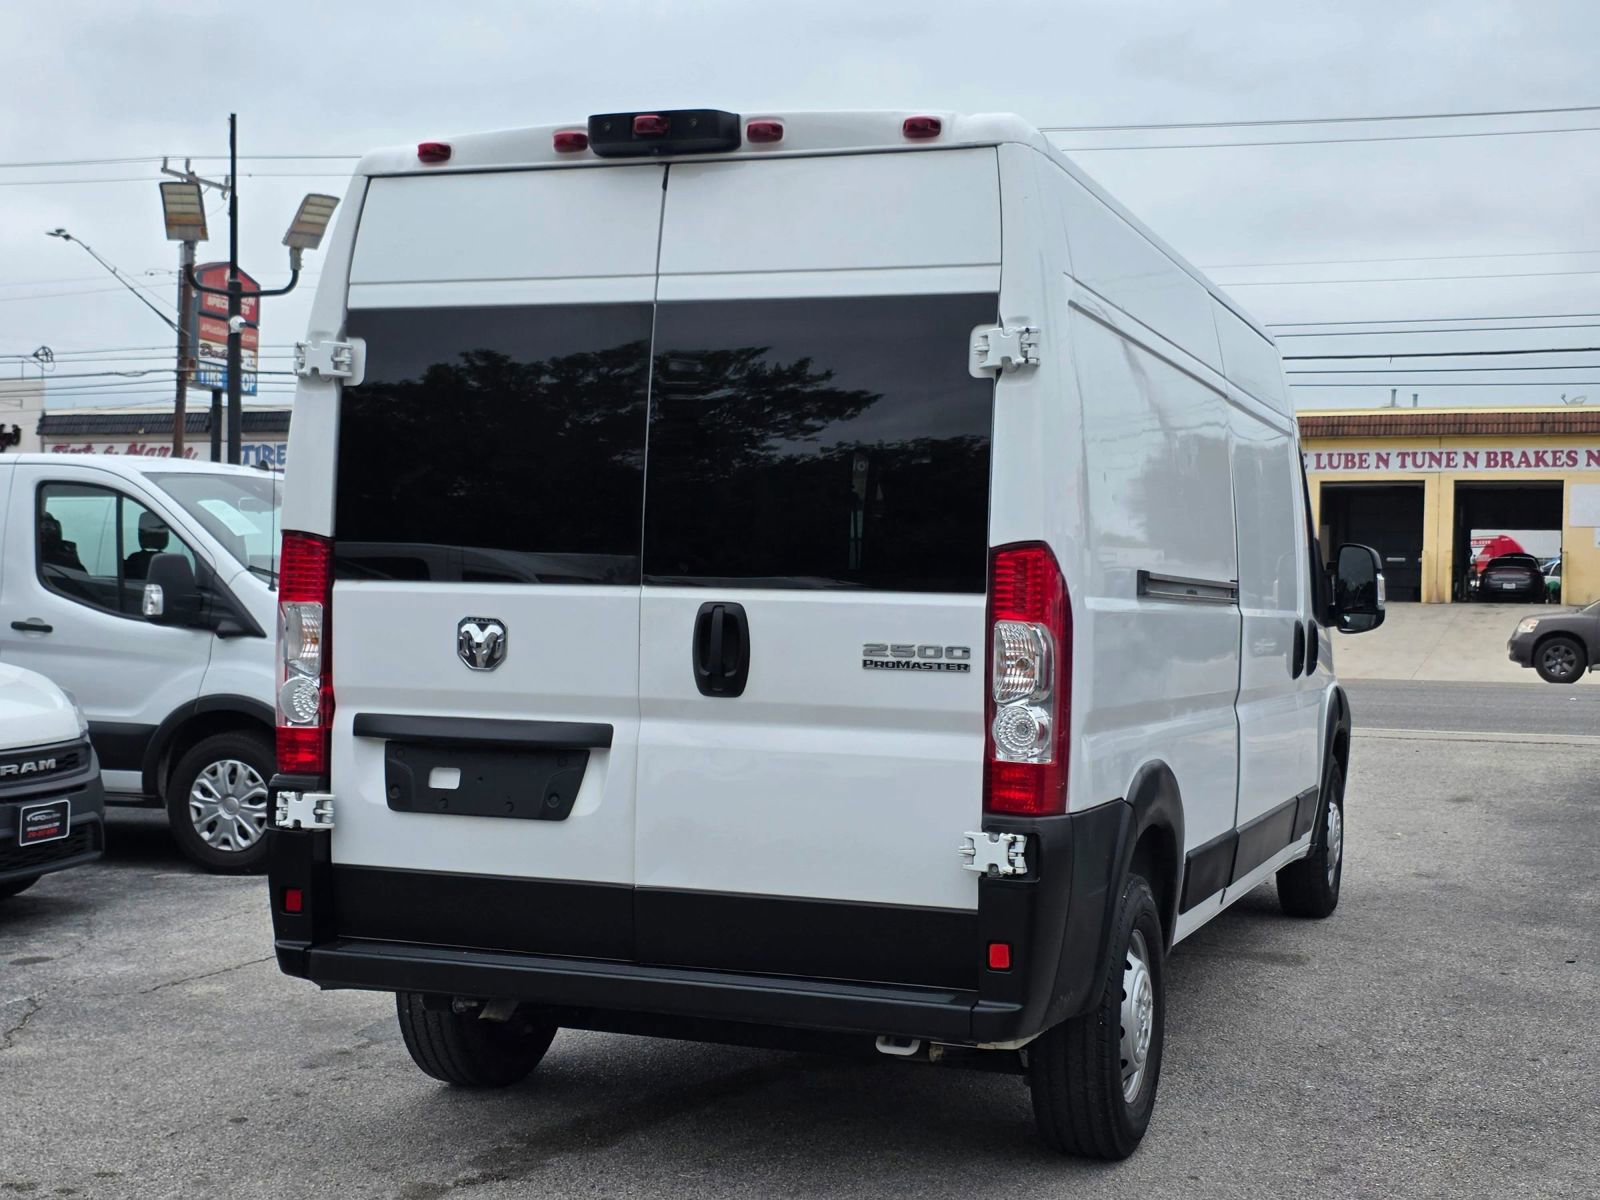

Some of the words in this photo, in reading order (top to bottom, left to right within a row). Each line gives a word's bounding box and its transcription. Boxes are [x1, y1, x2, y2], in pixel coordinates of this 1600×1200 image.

[1315, 452, 1370, 470] LUBE
[1375, 452, 1391, 470] N
[1396, 451, 1458, 469] TUNE
[1463, 451, 1479, 469] N
[1485, 449, 1578, 468] BRAKES
[862, 643, 971, 660] 2500
[0, 758, 56, 776] RAM
